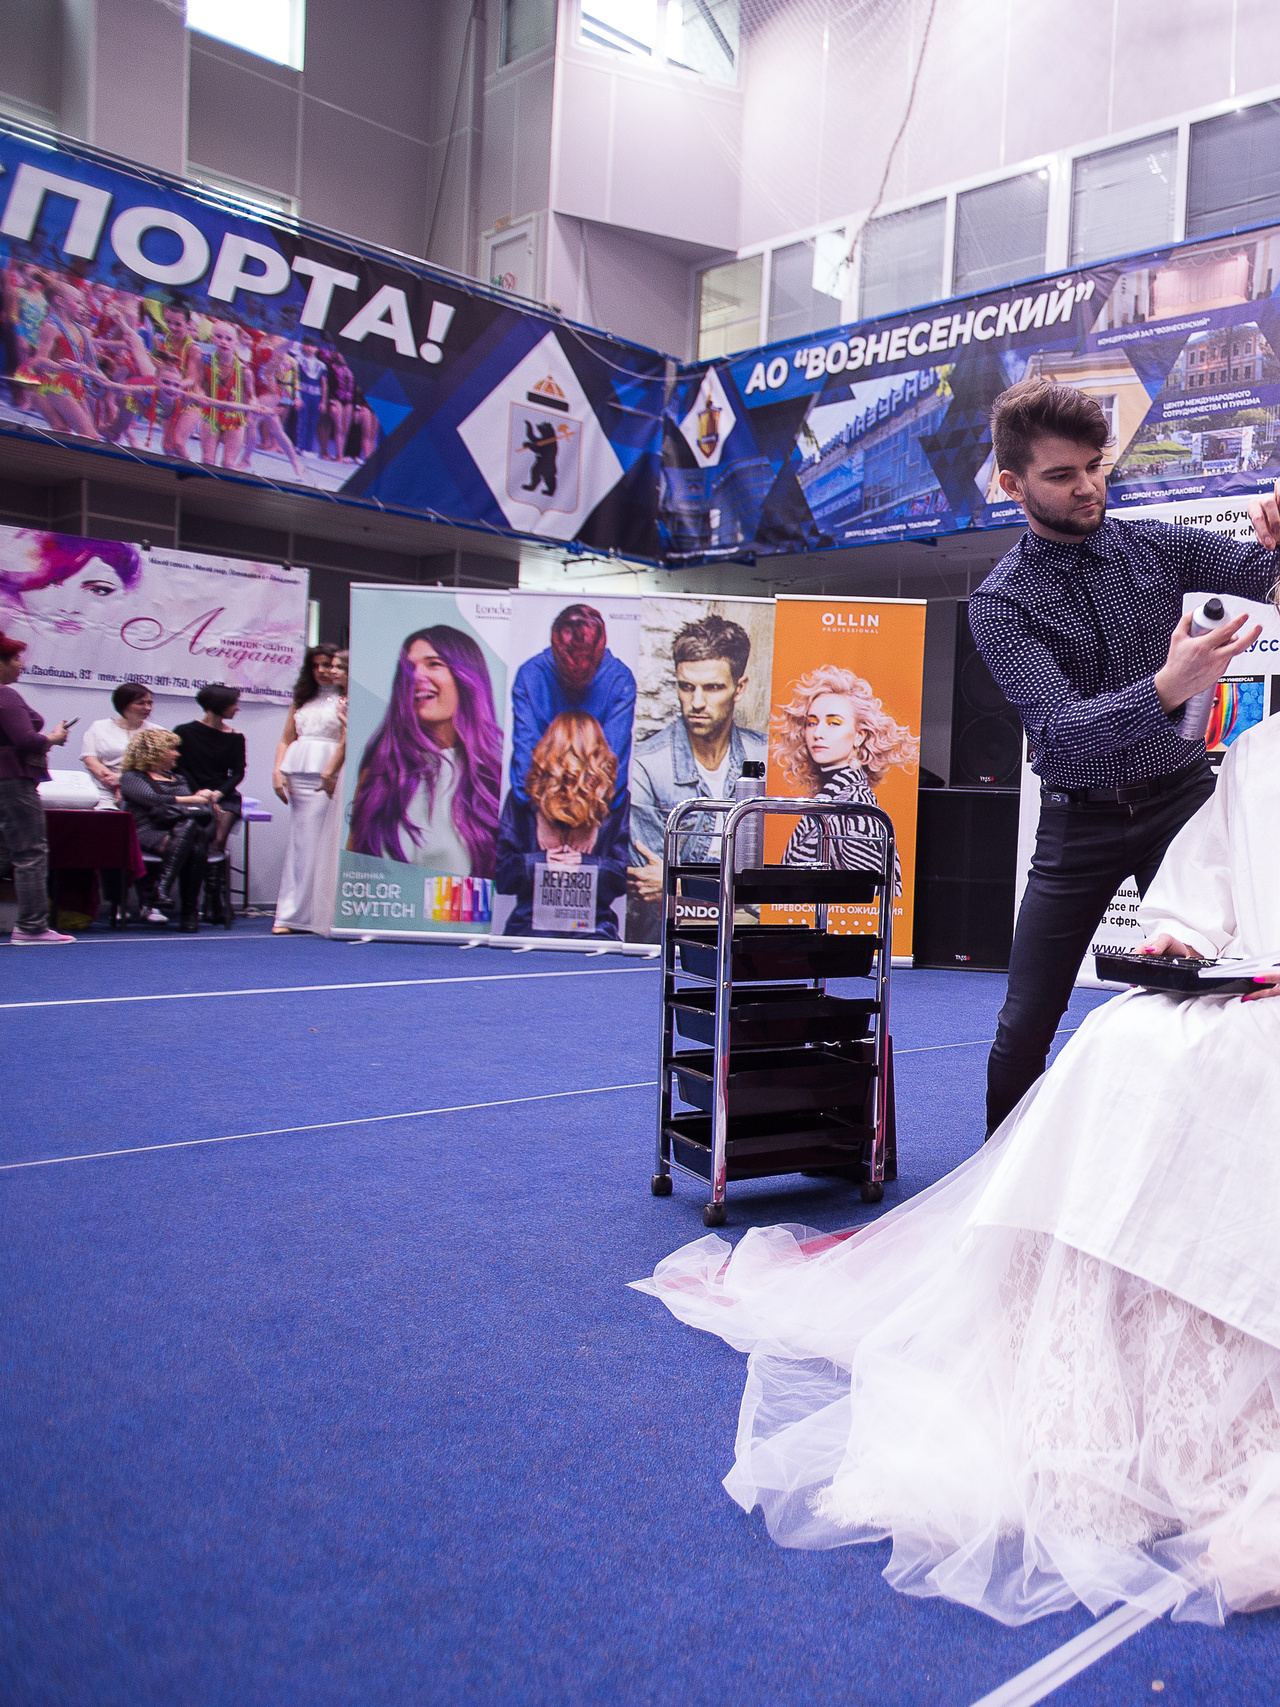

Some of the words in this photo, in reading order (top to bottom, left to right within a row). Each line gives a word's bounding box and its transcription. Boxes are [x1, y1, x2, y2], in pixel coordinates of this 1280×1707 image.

[0, 162, 455, 364] ПОРТА!
[745, 357, 789, 395] АО
[842, 366, 940, 444] ЛАЗУРНЫ
[1162, 403, 1222, 419] СОТРУДНИЧЕСТВА
[1229, 397, 1261, 410] ТУРИЗМА
[1163, 400, 1184, 411] ЦЕНТР
[1184, 389, 1252, 407] МЕЖДУНАРОДНОГО
[1174, 512, 1212, 525] Центр
[1216, 510, 1251, 523] обуч
[821, 612, 879, 627] OLLIN
[120, 606, 294, 669] Лендана
[341, 882, 401, 898] COLOR
[341, 901, 415, 918] SWITCH
[676, 905, 719, 919] ONDO
[771, 903, 846, 914] ПРЕВОСХИТЬ
[847, 905, 903, 916] ОЖИДИЯ
